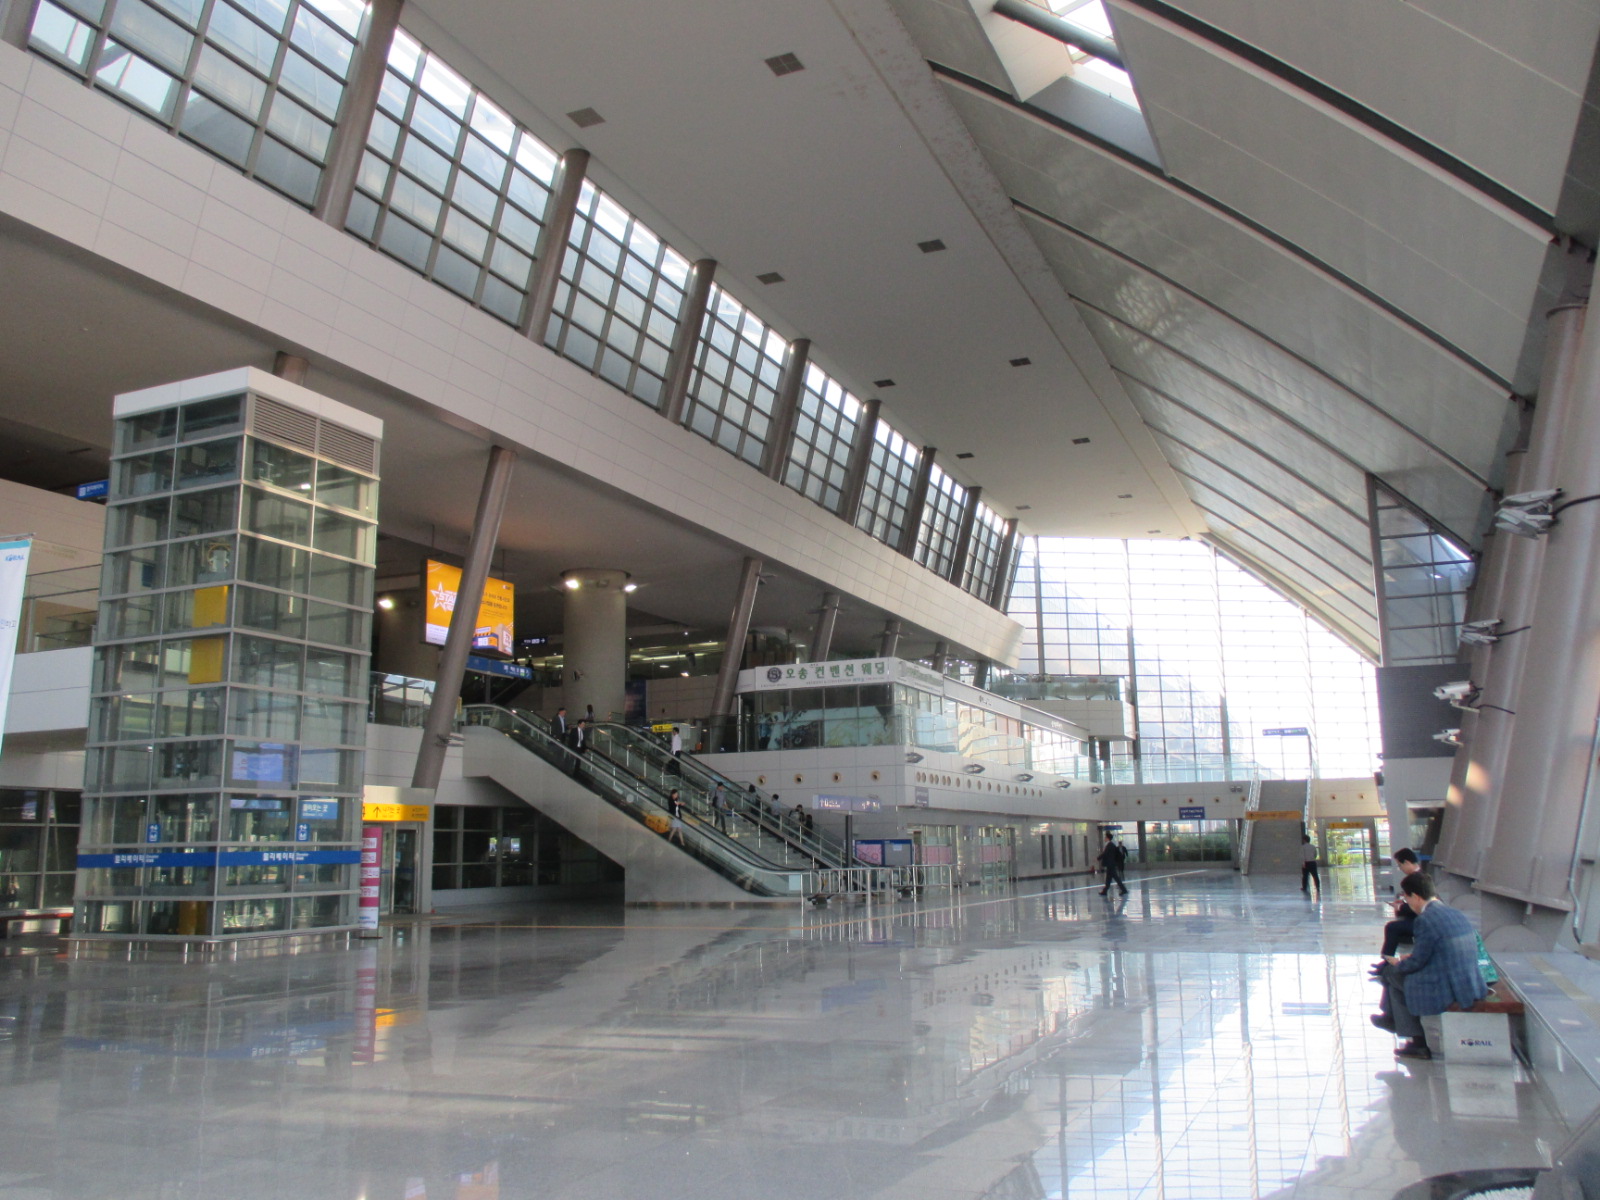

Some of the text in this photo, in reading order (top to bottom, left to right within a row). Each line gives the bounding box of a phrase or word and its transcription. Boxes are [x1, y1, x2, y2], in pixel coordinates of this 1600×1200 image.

[785, 667, 809, 681] 오송
[861, 661, 885, 677] 웨딩
[1460, 1038, 1493, 1047] KORAIL
